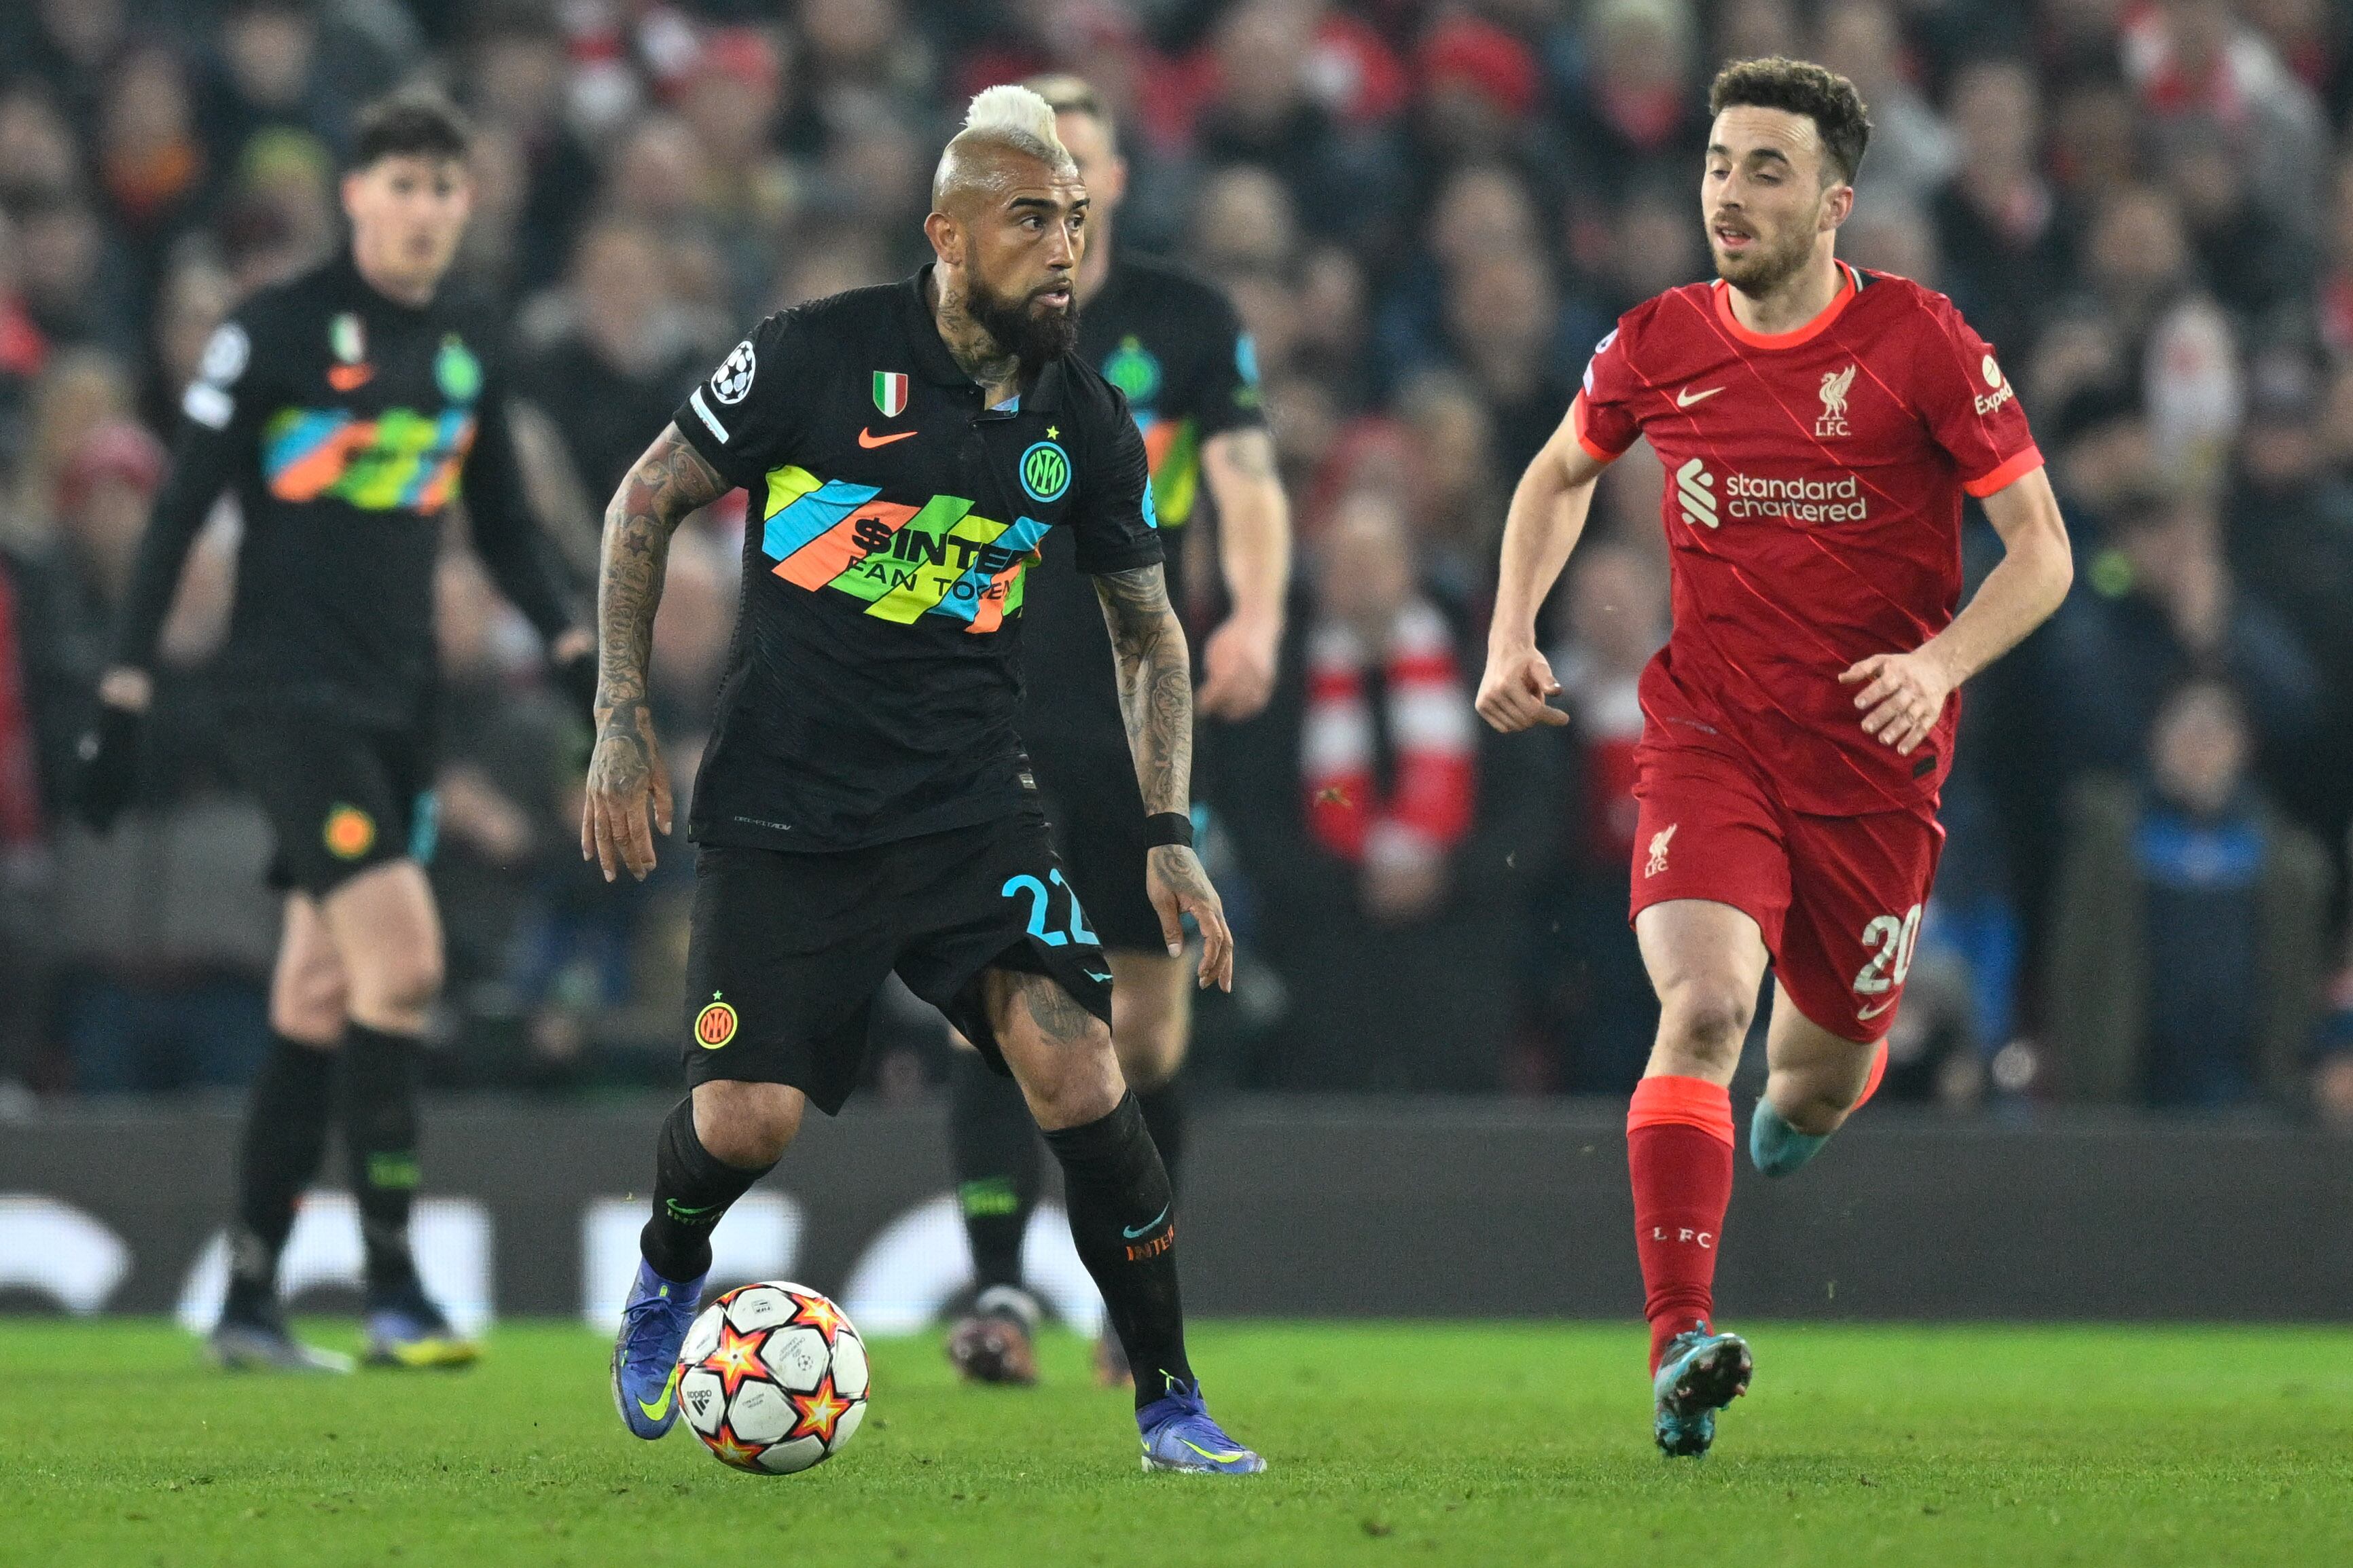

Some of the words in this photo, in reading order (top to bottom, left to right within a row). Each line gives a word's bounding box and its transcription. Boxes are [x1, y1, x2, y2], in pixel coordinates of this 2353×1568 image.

[1726, 473, 1856, 500] standard
[1728, 497, 1867, 522] chartered
[848, 555, 917, 592] FAN
[1001, 868, 1100, 947] 22
[1853, 902, 1922, 995] 20
